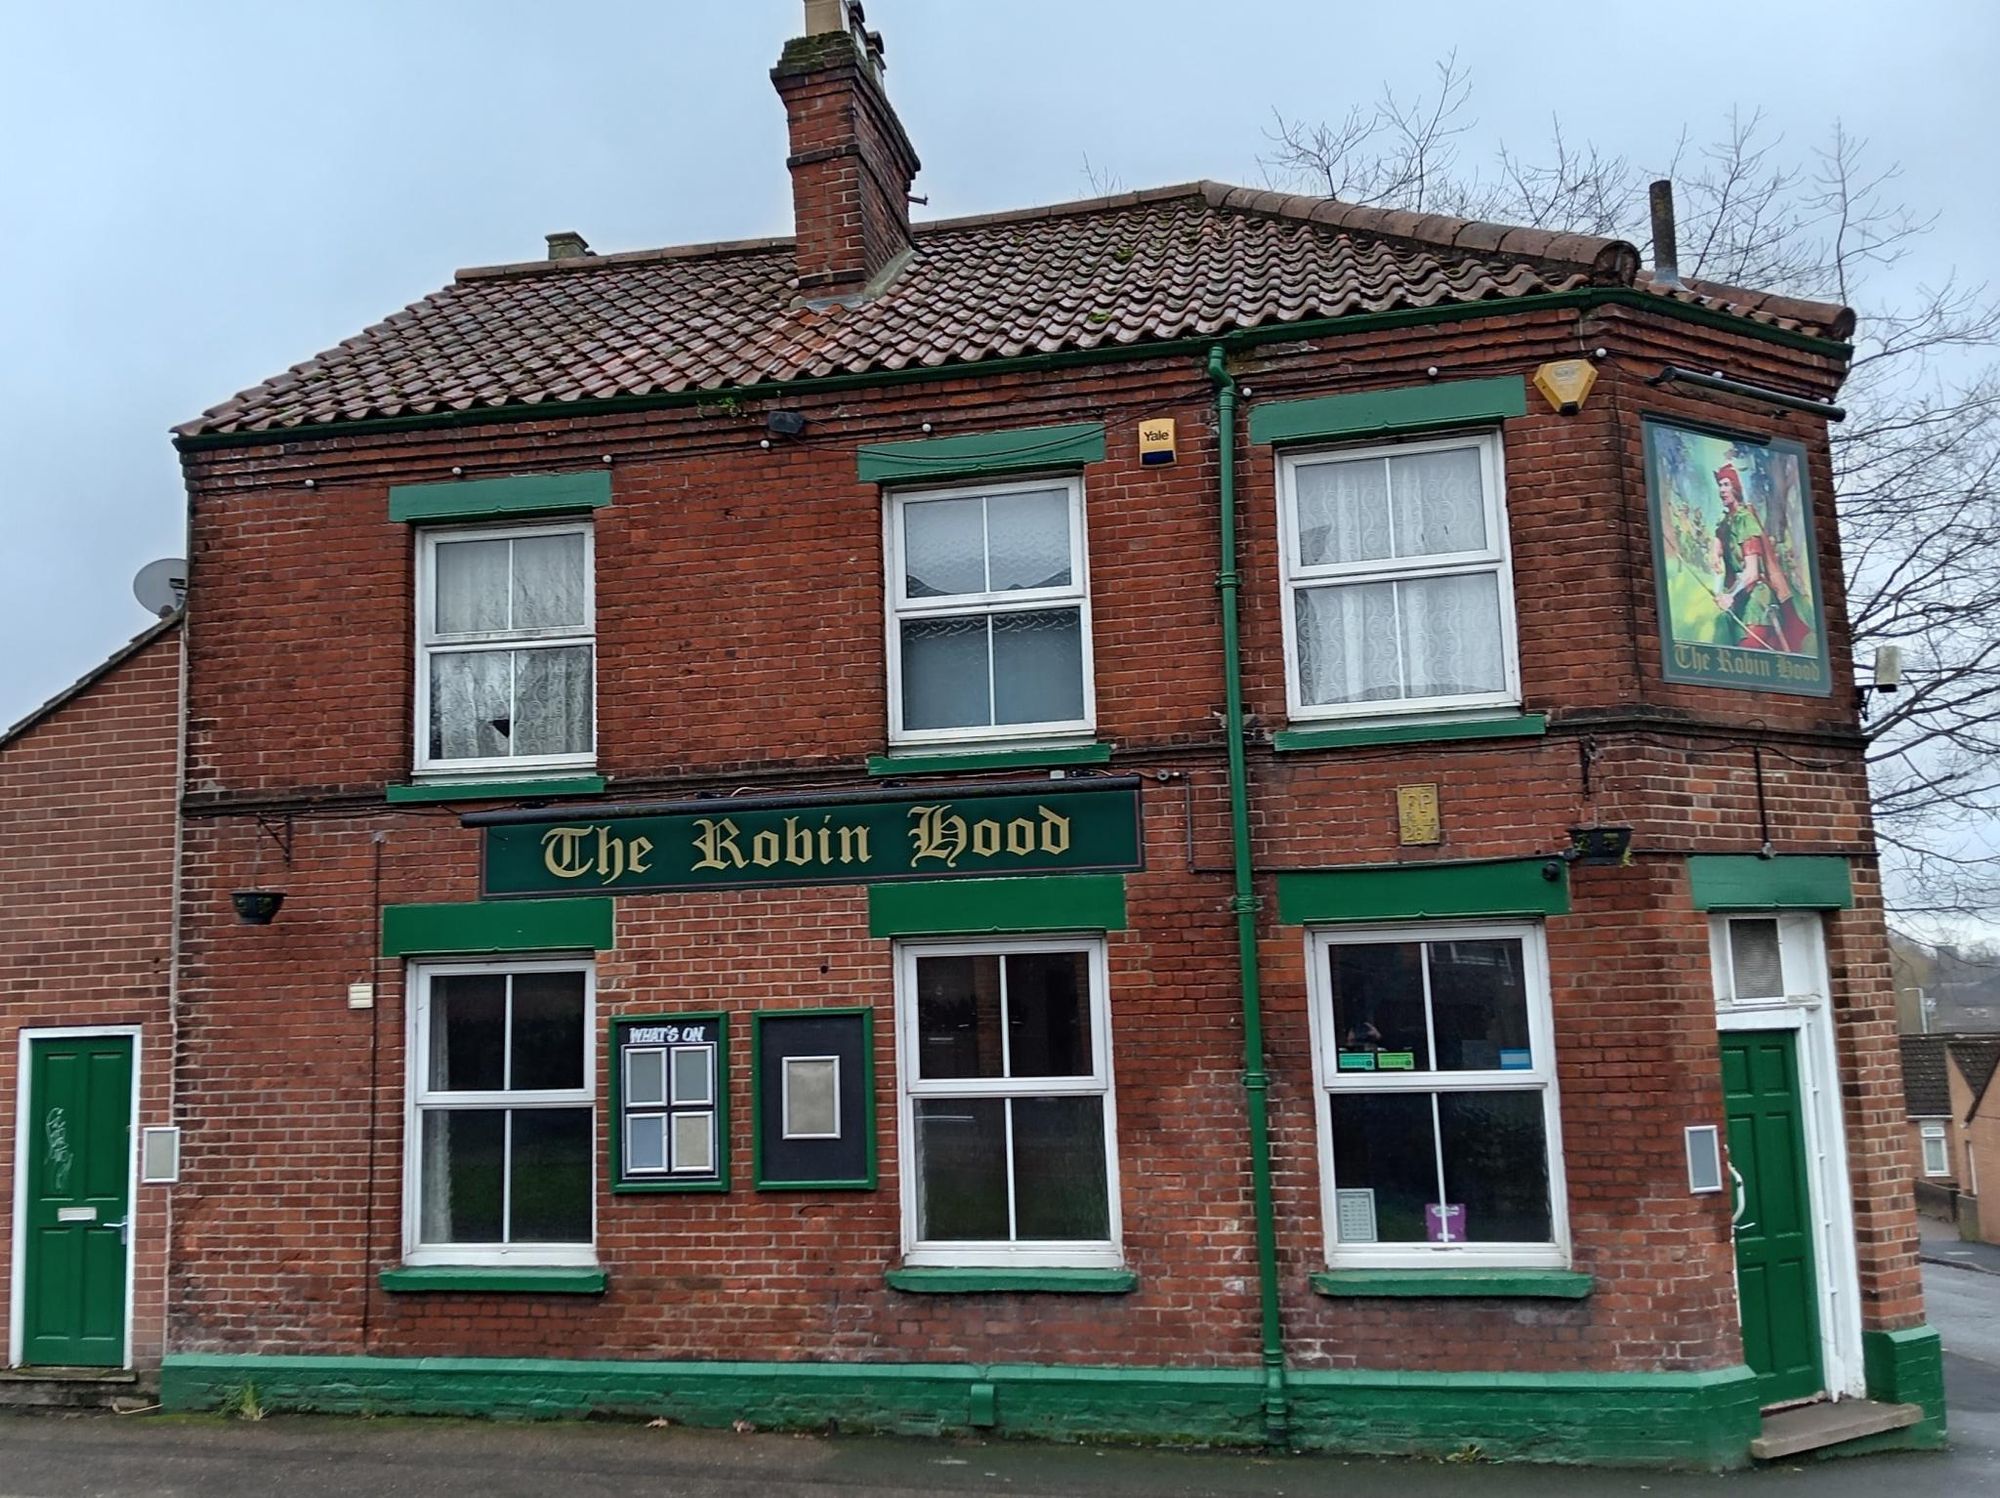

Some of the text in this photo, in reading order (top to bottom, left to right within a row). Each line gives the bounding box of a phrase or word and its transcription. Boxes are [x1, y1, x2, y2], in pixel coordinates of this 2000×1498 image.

[1144, 430, 1169, 442] Yale
[1673, 643, 1820, 683] The Robin Hood
[540, 803, 1071, 886] The Robin Hood
[628, 1025, 706, 1044] WHAT'S ON
